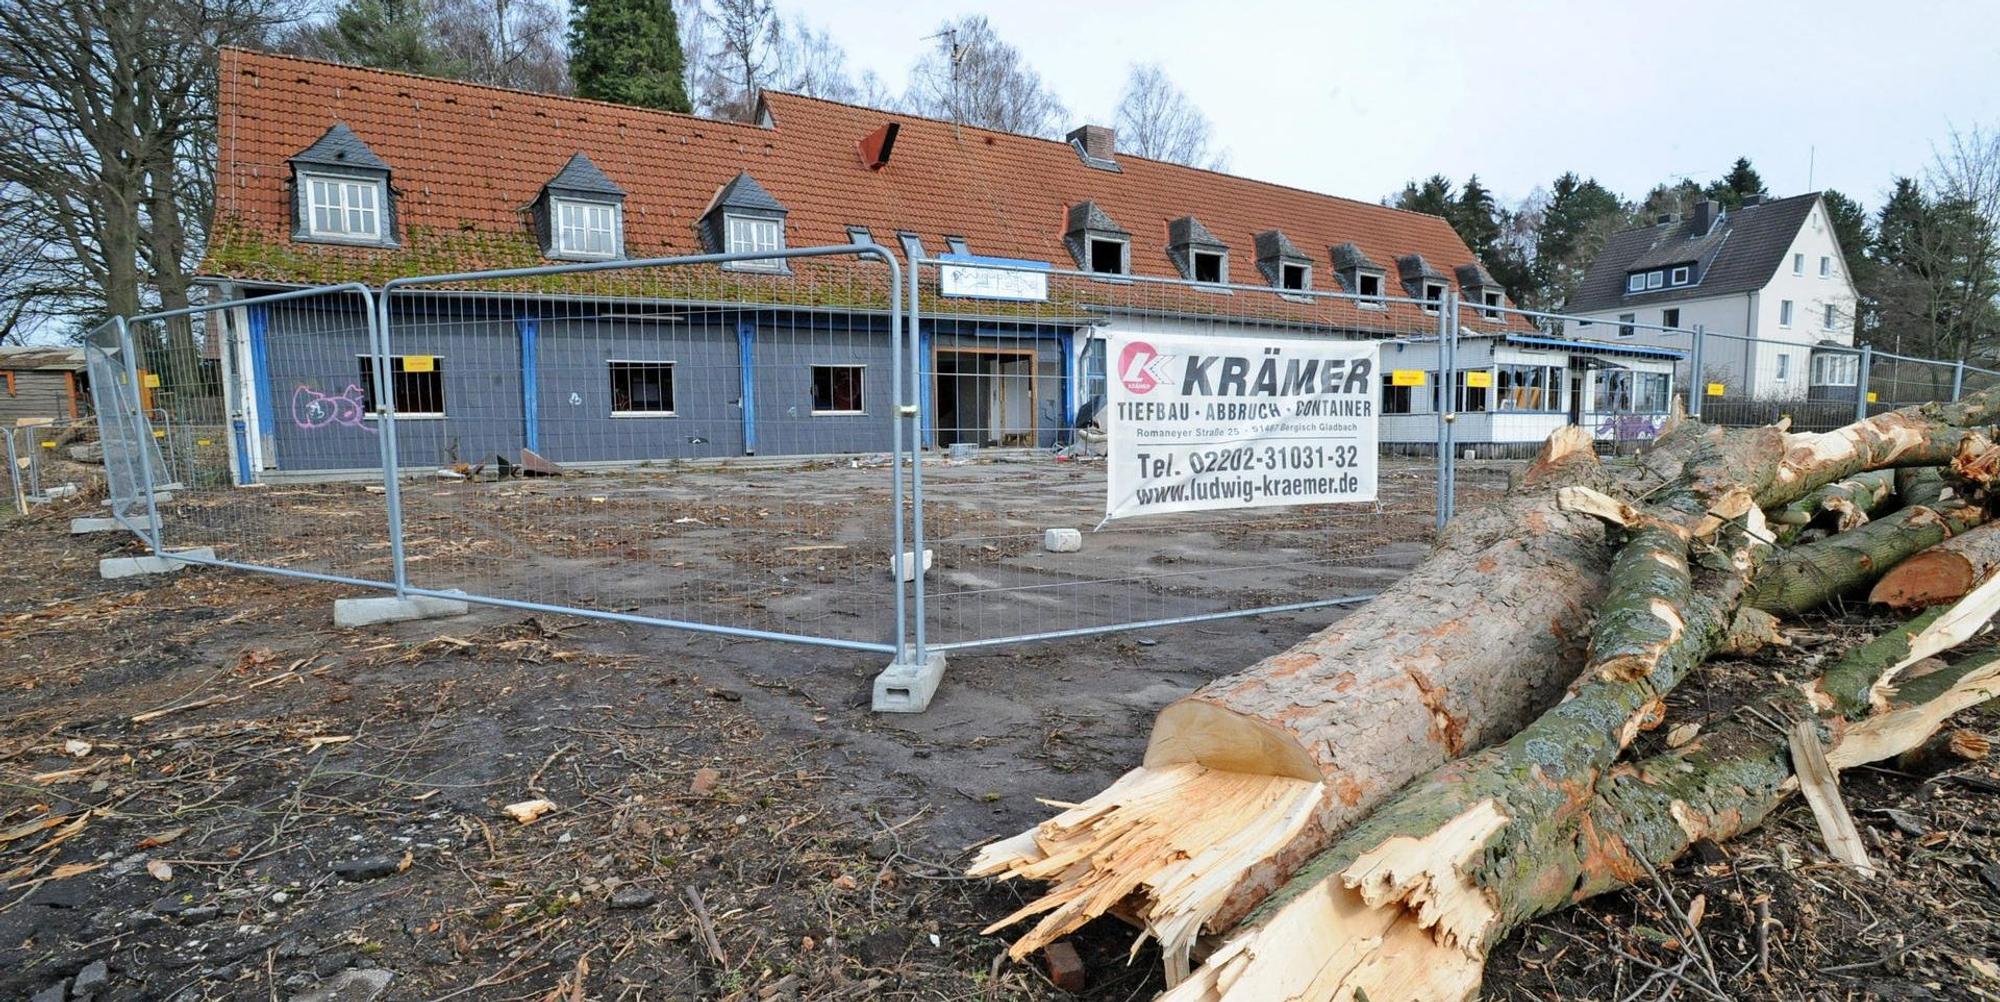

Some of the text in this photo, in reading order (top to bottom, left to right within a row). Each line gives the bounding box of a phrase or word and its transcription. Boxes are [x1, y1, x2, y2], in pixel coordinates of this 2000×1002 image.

[1182, 348, 1372, 396] KRÄMER
[1117, 402, 1190, 421] TIEFBAU
[1206, 402, 1281, 421] ABBRUCH
[1295, 400, 1371, 418] CONTAINER
[1137, 428, 1193, 438] Romaneyer
[1196, 427, 1225, 437] Straße
[1228, 427, 1240, 436] 25
[1280, 423, 1317, 433] Bergisch
[1319, 422, 1358, 432] Gladbach
[1137, 446, 1358, 478] Tel. 02202-31031-32
[1136, 473, 1358, 506] www.ludwig-kraemer.de
